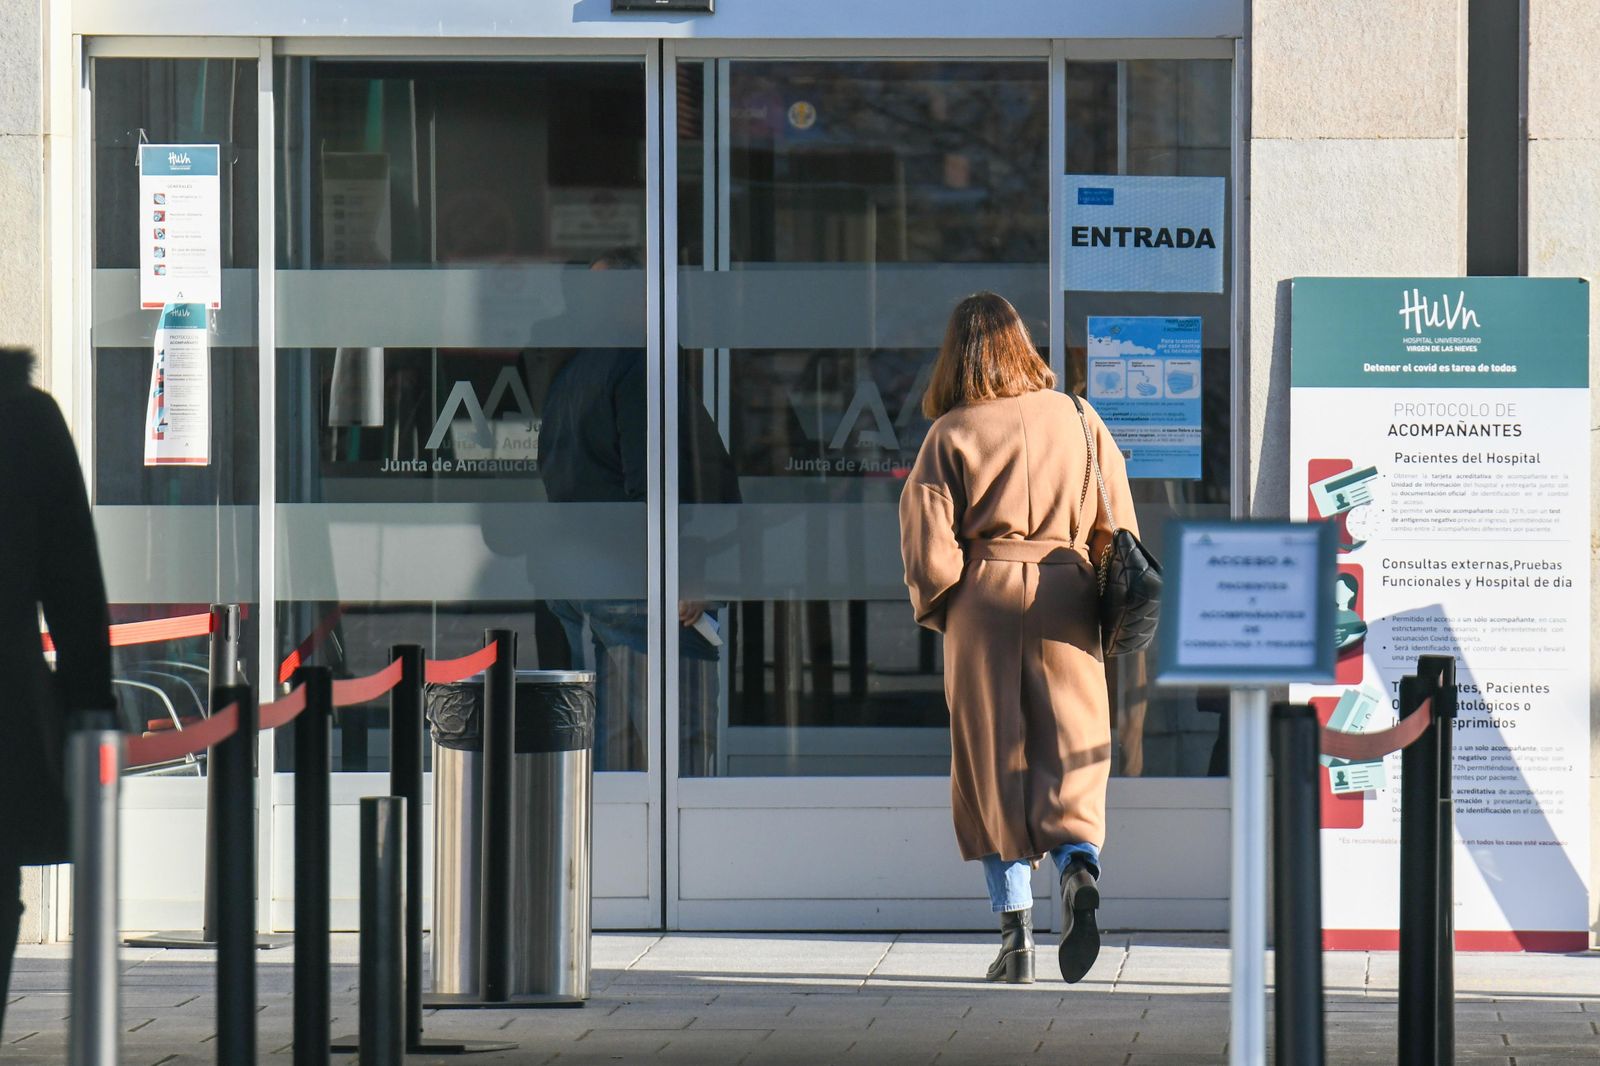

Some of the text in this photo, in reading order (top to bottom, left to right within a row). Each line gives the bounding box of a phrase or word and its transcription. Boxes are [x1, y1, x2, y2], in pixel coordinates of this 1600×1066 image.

[1071, 226, 1216, 249] ENTRADA
[1363, 362, 1517, 373] Detener el covid es tarea de todos
[1393, 403, 1516, 417] PROTOCOLO DE
[1387, 420, 1522, 437] ACOMPAÑANTES
[380, 457, 538, 472] Junta de Andalucía
[783, 457, 831, 472] Junta
[835, 457, 856, 472] de
[1394, 452, 1541, 466] Pacientes del Hospital
[1432, 472, 1452, 480] tarjeta
[1456, 472, 1491, 480] acreditativa
[1207, 555, 1296, 566] ACCESO A
[1382, 558, 1447, 570] Consultas
[1382, 575, 1461, 587] Funcionales
[1465, 578, 1471, 589] y
[1476, 575, 1530, 589] Hospital
[1534, 576, 1549, 588] de
[1392, 615, 1424, 623] Permitido
[1434, 615, 1455, 623] acceso
[1411, 644, 1450, 652] identificado
[1452, 644, 1461, 652] en
[1486, 682, 1550, 694] Pacientes
[1456, 787, 1496, 795] acreditativa
[1456, 806, 1465, 814] de
[1466, 806, 1511, 814] identificación
[1512, 806, 1521, 814] en
